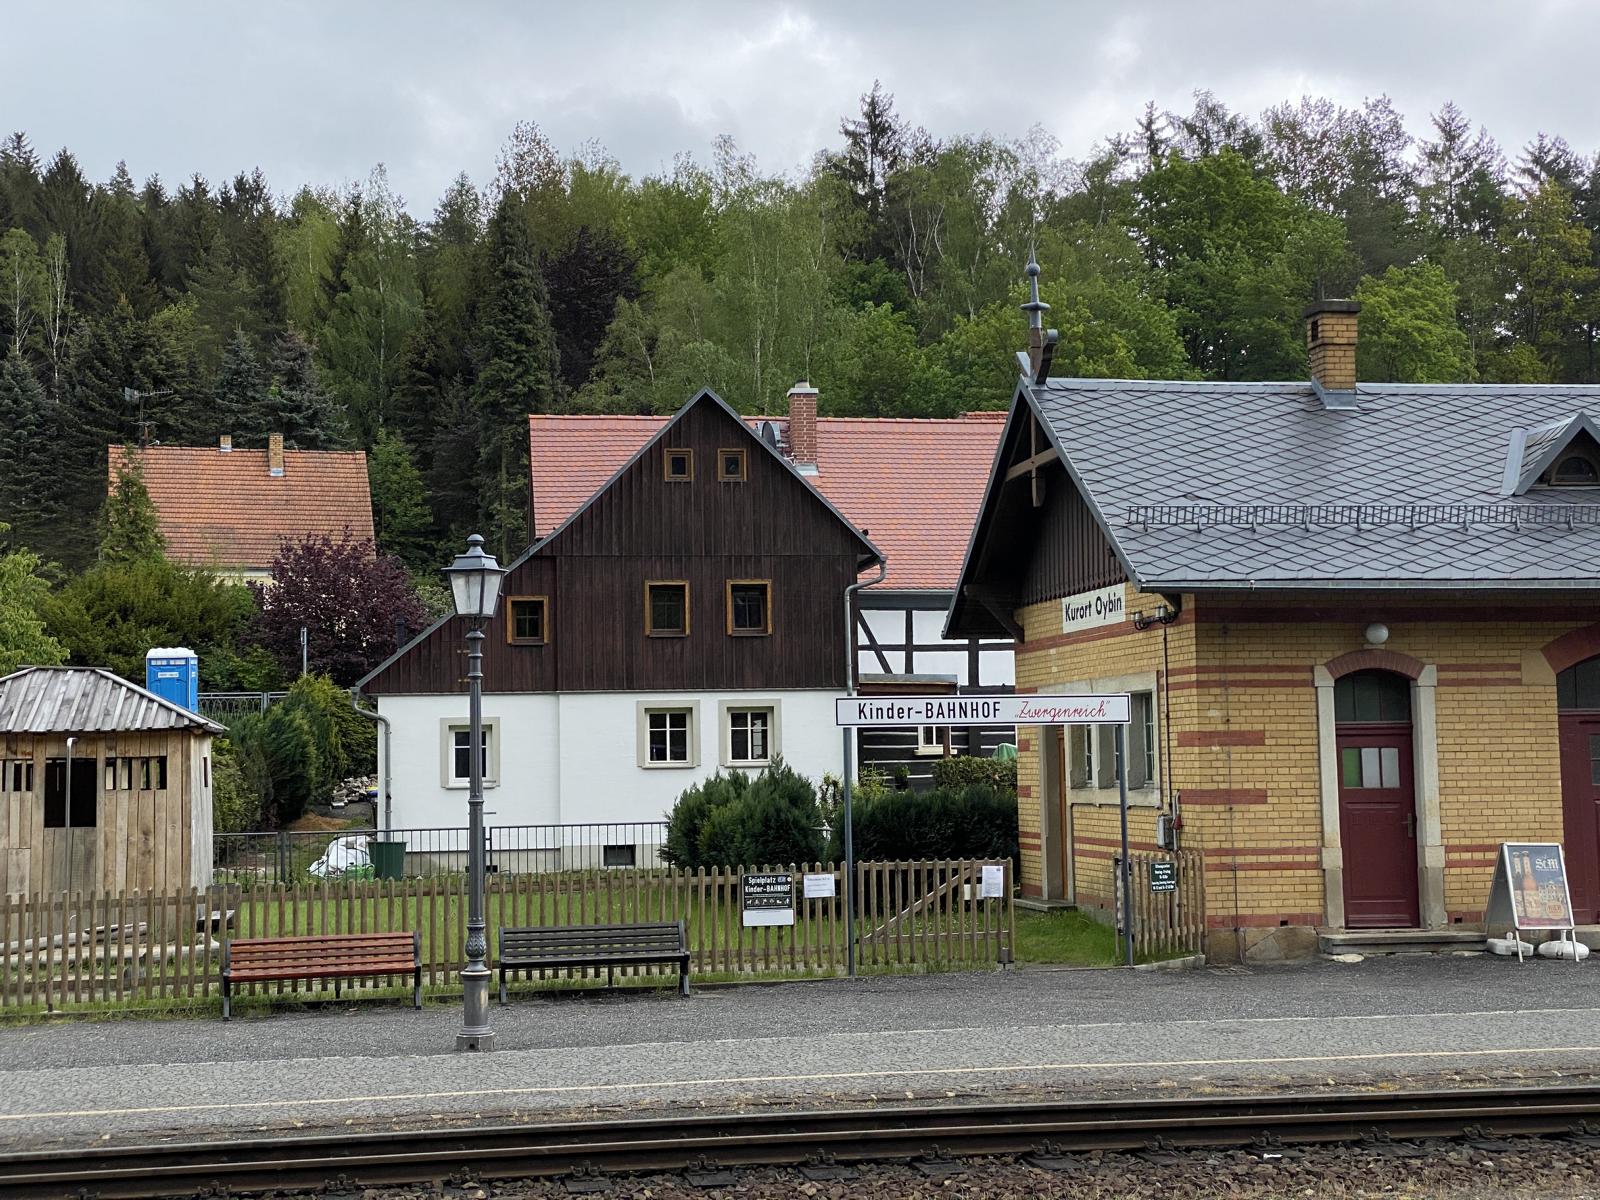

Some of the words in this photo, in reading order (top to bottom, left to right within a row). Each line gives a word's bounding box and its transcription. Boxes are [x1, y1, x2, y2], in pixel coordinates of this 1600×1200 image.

[1065, 600, 1092, 622] Kurort
[1095, 592, 1122, 620] Oybin
[858, 701, 1001, 720] Kinder-BAHNHOF
[748, 876, 776, 885] Spielplatz
[744, 884, 791, 892] Kinder-BAHNHOF
